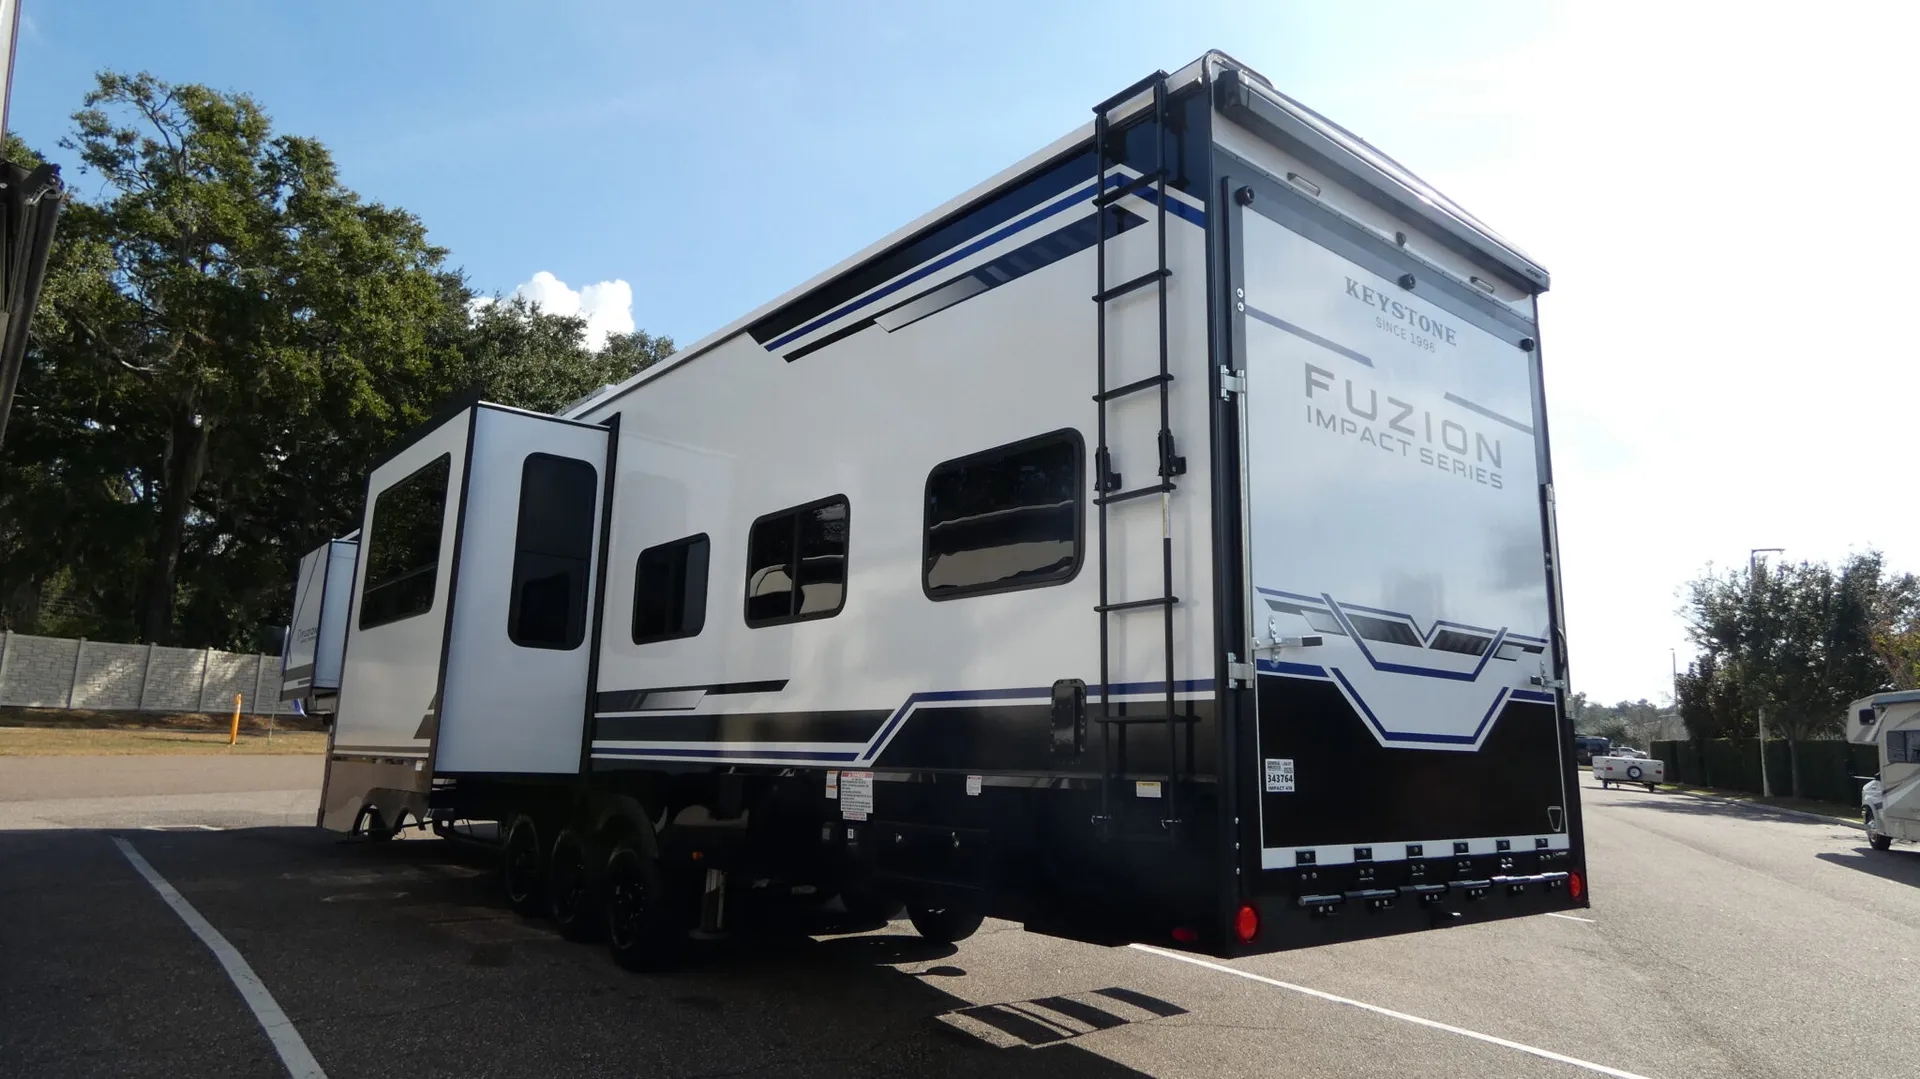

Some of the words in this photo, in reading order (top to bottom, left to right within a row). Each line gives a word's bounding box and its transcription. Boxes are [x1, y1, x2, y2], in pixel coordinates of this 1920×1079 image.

[1344, 276, 1457, 347] KEYSTONE
[1375, 316, 1407, 341] SINCE
[1410, 332, 1436, 354] 1996
[1304, 362, 1502, 470] FUZION
[1306, 405, 1412, 458] IMPACT
[1419, 447, 1503, 490] SERIES
[1267, 774, 1294, 783] 343764
